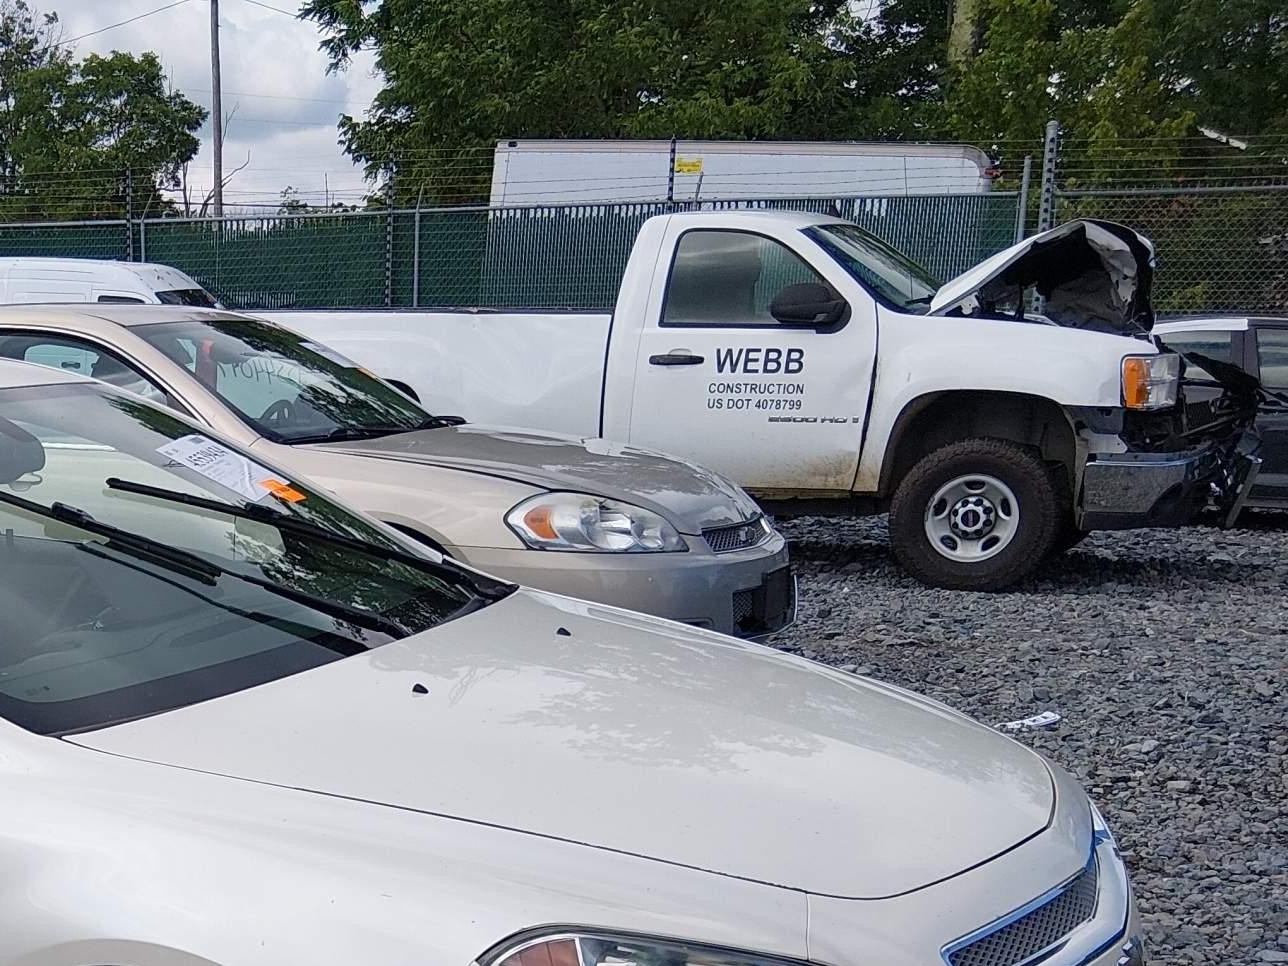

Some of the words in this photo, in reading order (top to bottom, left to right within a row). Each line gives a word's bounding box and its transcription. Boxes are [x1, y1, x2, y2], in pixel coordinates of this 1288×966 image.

[716, 348, 805, 374] WEBB
[708, 383, 805, 395] CONSTRUCTION
[707, 398, 723, 410] US
[727, 398, 752, 410] DOT
[755, 398, 802, 410] 4078799
